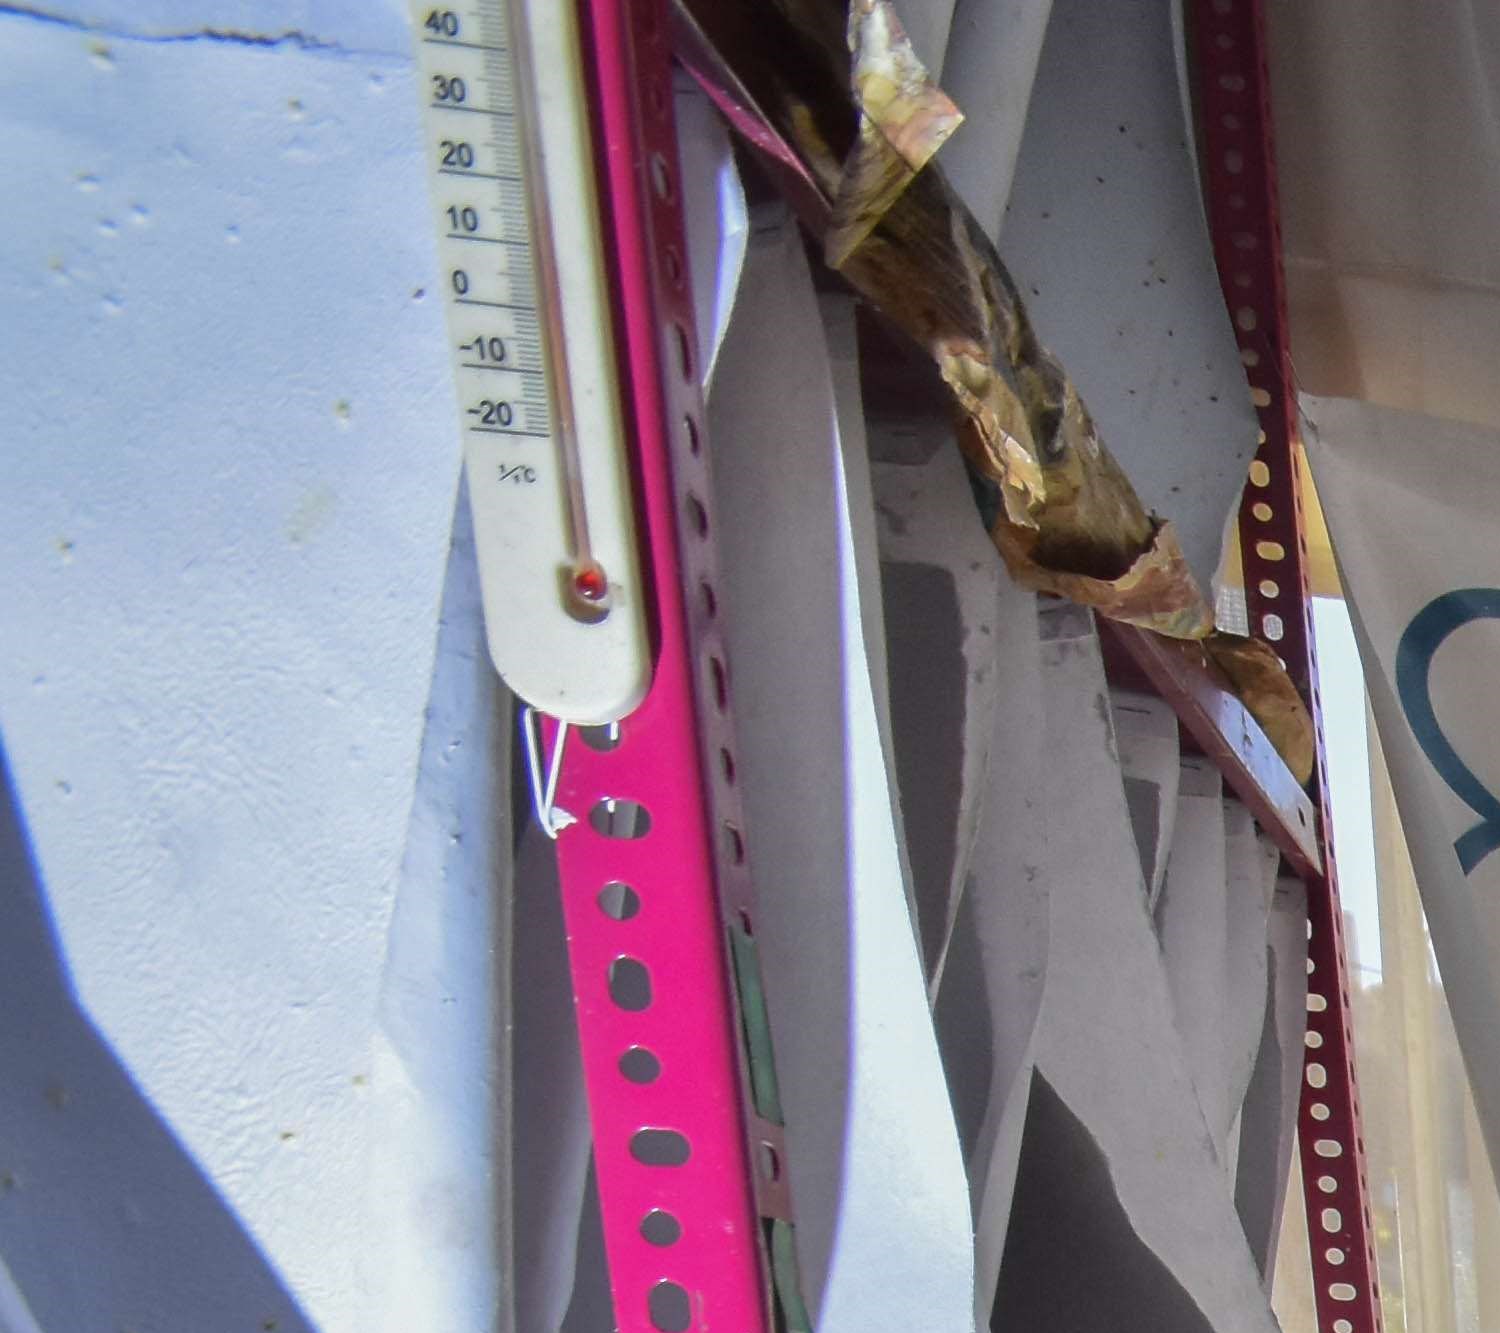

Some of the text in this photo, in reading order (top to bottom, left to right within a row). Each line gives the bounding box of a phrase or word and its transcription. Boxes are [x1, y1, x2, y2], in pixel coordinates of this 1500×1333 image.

[424, 10, 459, 37] 40
[432, 74, 466, 104] 30
[440, 140, 474, 169] 20
[446, 205, 478, 232] 10
[452, 269, 469, 296] 0
[459, 335, 507, 363] -10
[466, 399, 513, 427] -20
